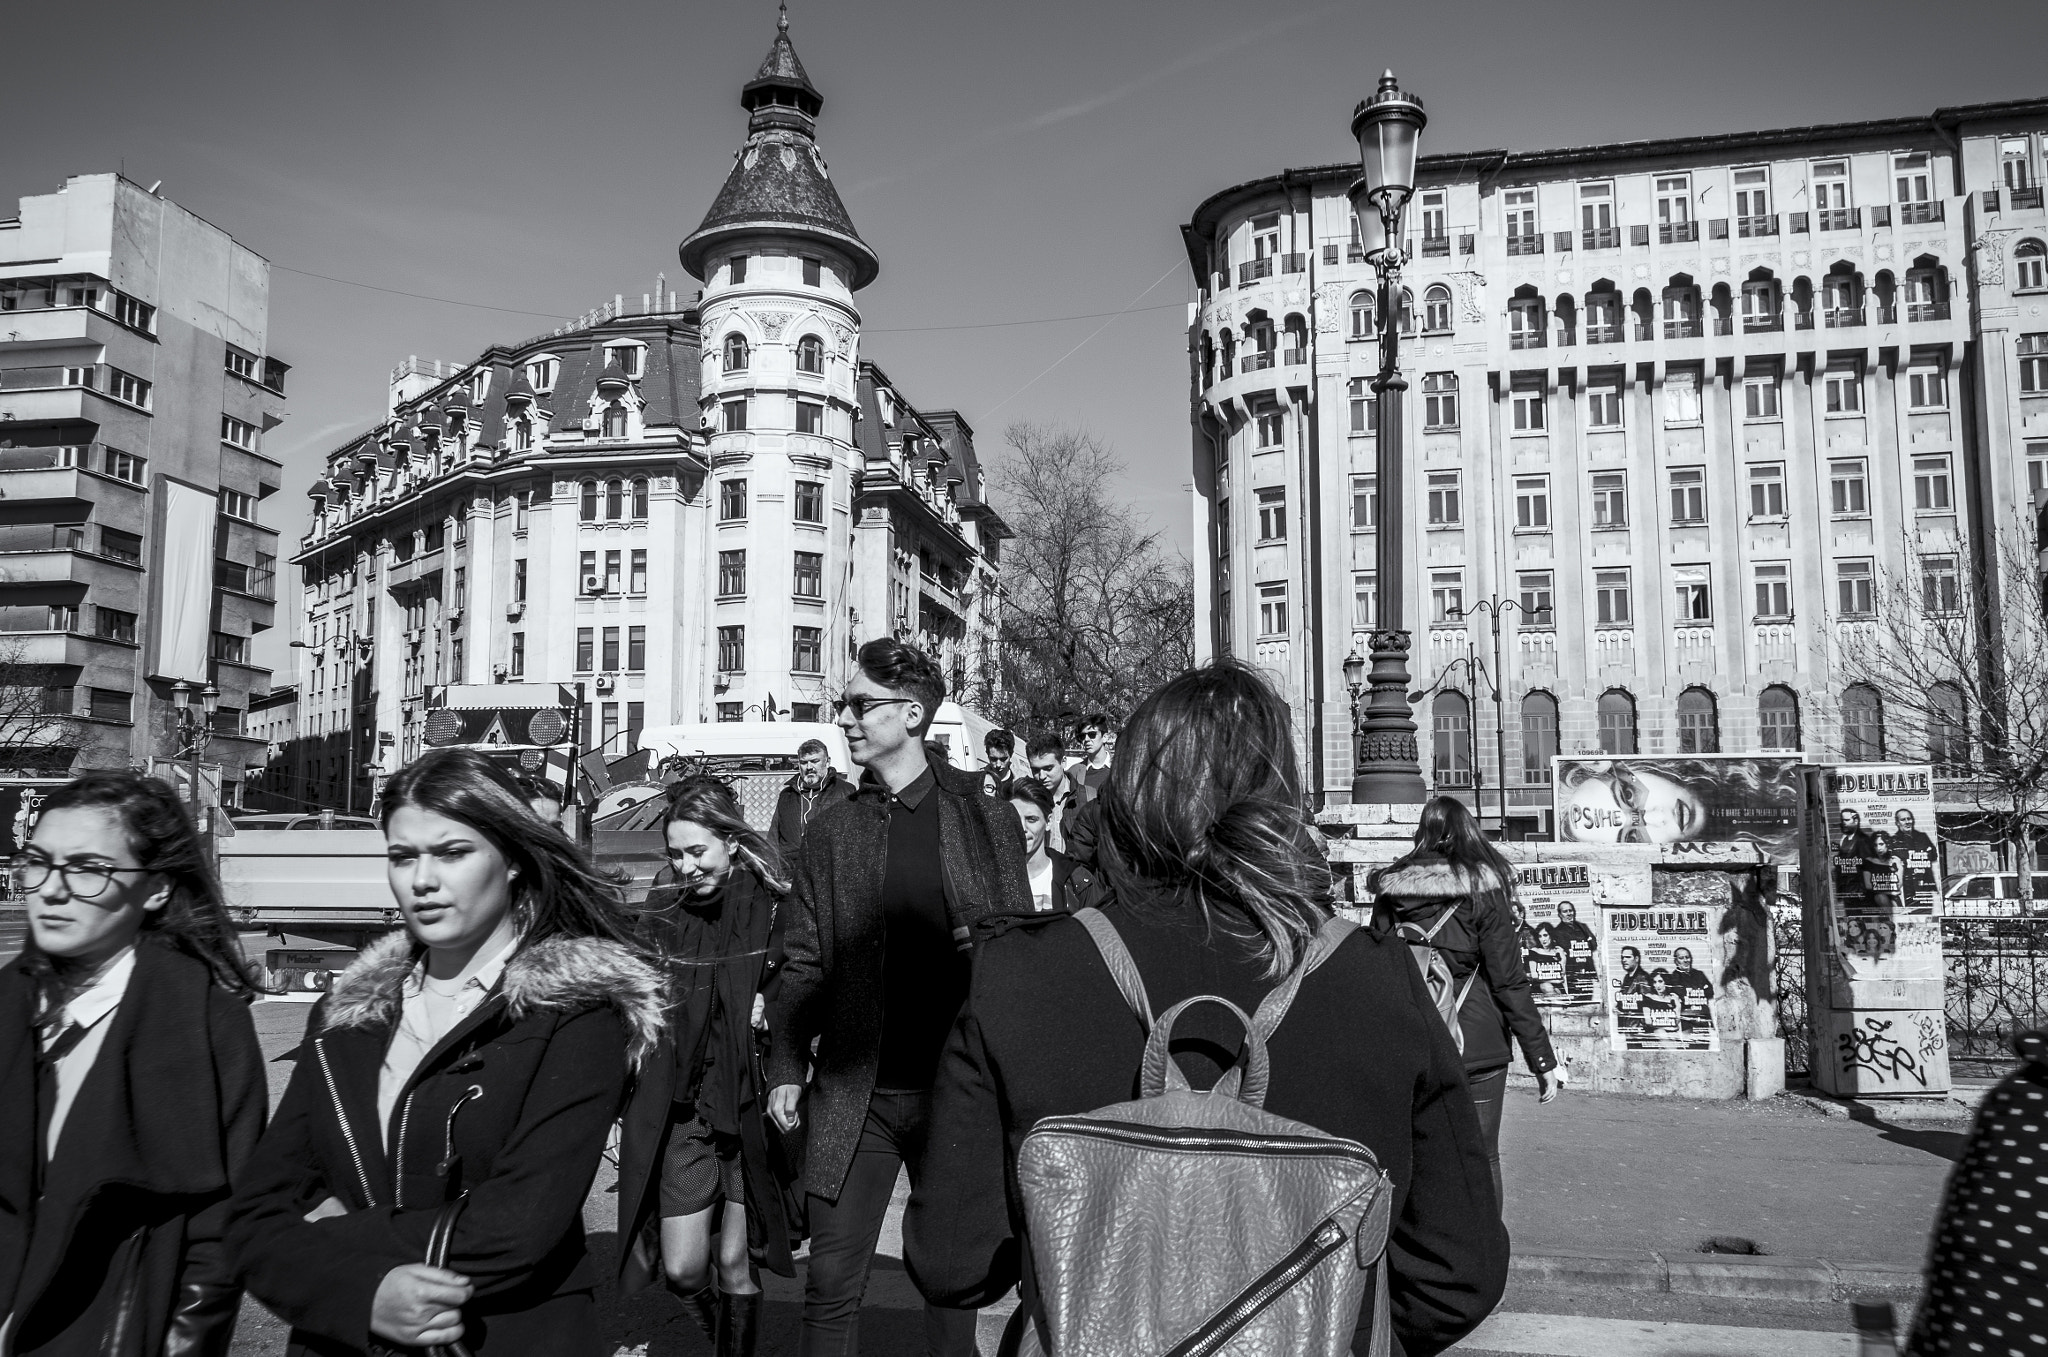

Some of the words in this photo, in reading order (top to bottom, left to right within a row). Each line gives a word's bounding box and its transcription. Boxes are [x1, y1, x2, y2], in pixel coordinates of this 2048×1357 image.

[1826, 771, 1928, 793] FIDELITATE
[1569, 803, 1623, 830] PSIHE
[1834, 856, 1863, 868] Gheorghe
[1514, 865, 1589, 886] DELITATE
[1871, 873, 1899, 882] Adelaida
[1872, 881, 1899, 891] Zamfira
[1610, 911, 1708, 931] FIDELITATE
[286, 954, 325, 964] Master
